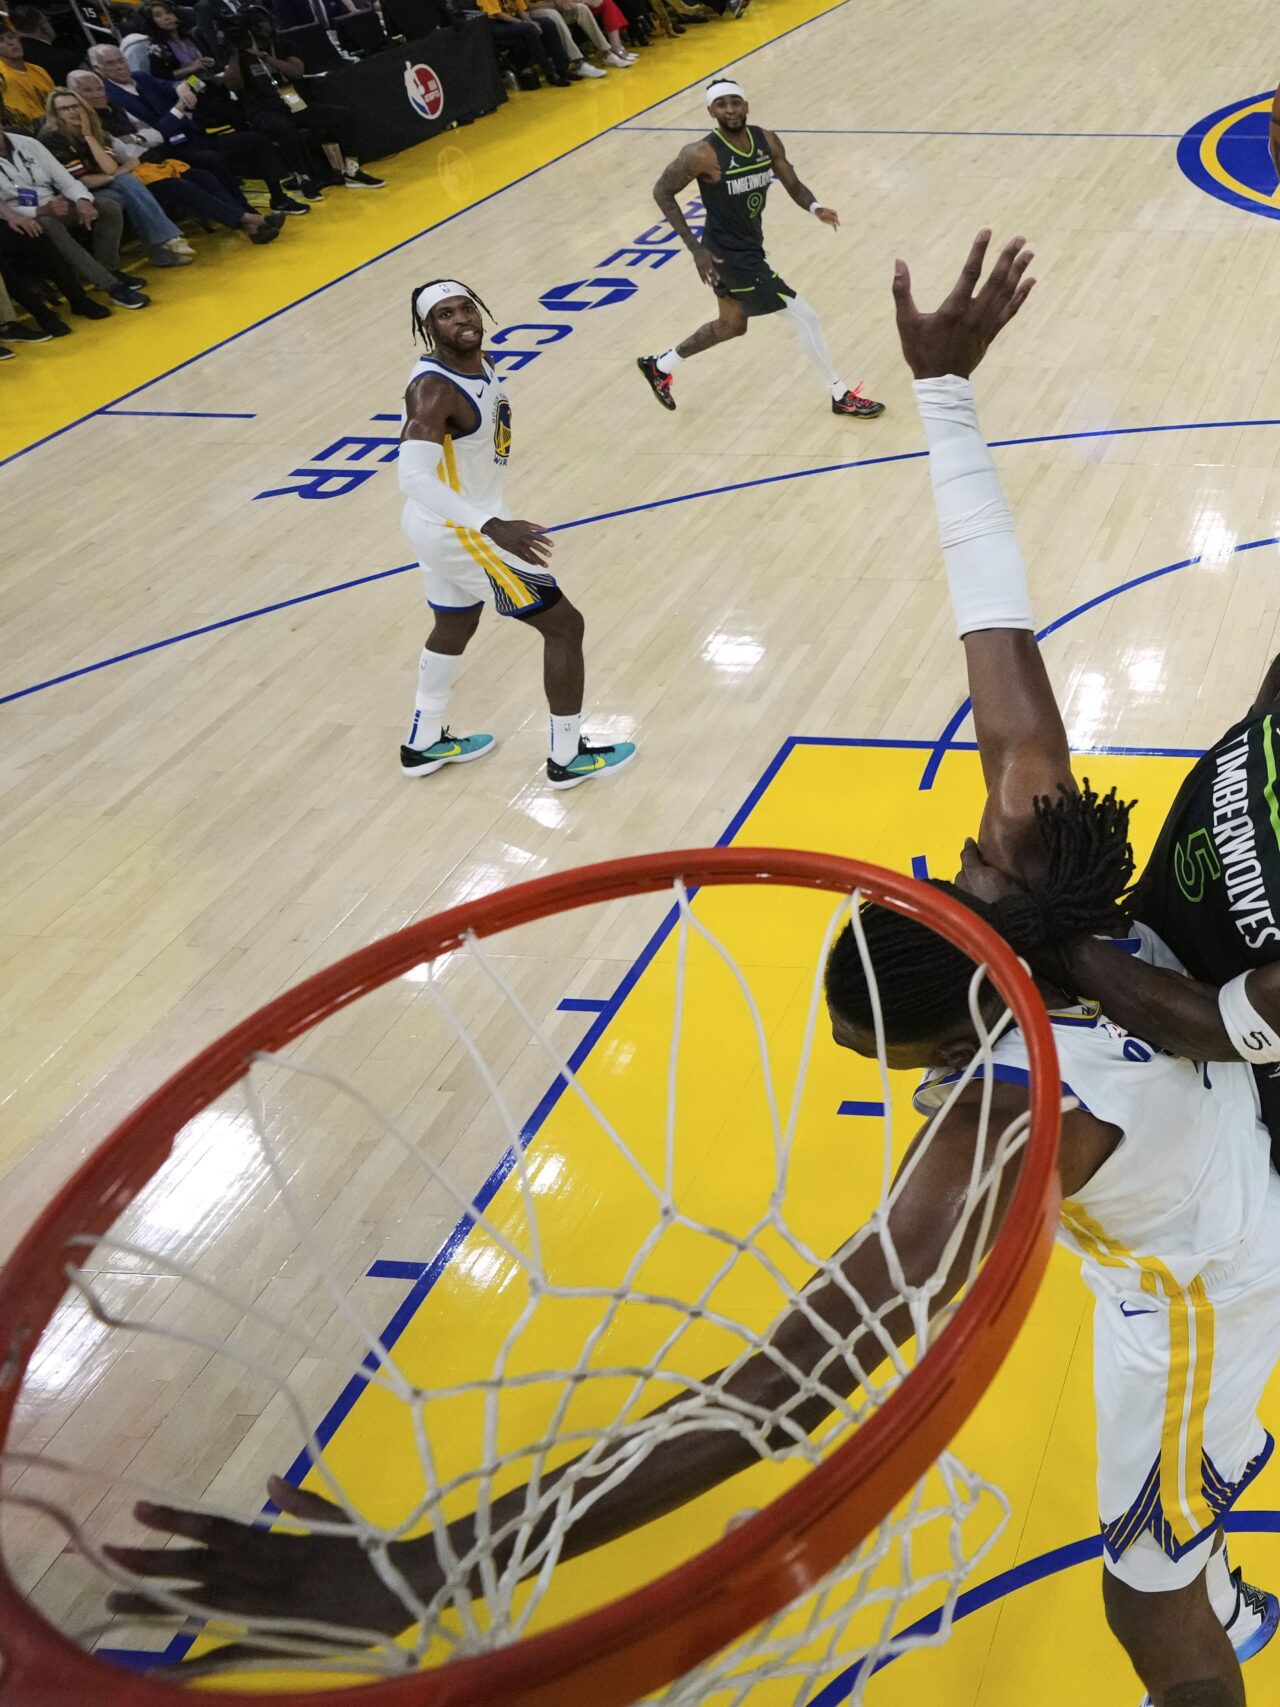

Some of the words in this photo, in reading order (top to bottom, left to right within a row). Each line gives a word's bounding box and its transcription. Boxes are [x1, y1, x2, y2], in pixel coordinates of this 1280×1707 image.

[747, 192, 763, 218] 9
[252, 323, 574, 501] CEER
[1174, 828, 1220, 902] 5
[1242, 1030, 1273, 1051] 5
